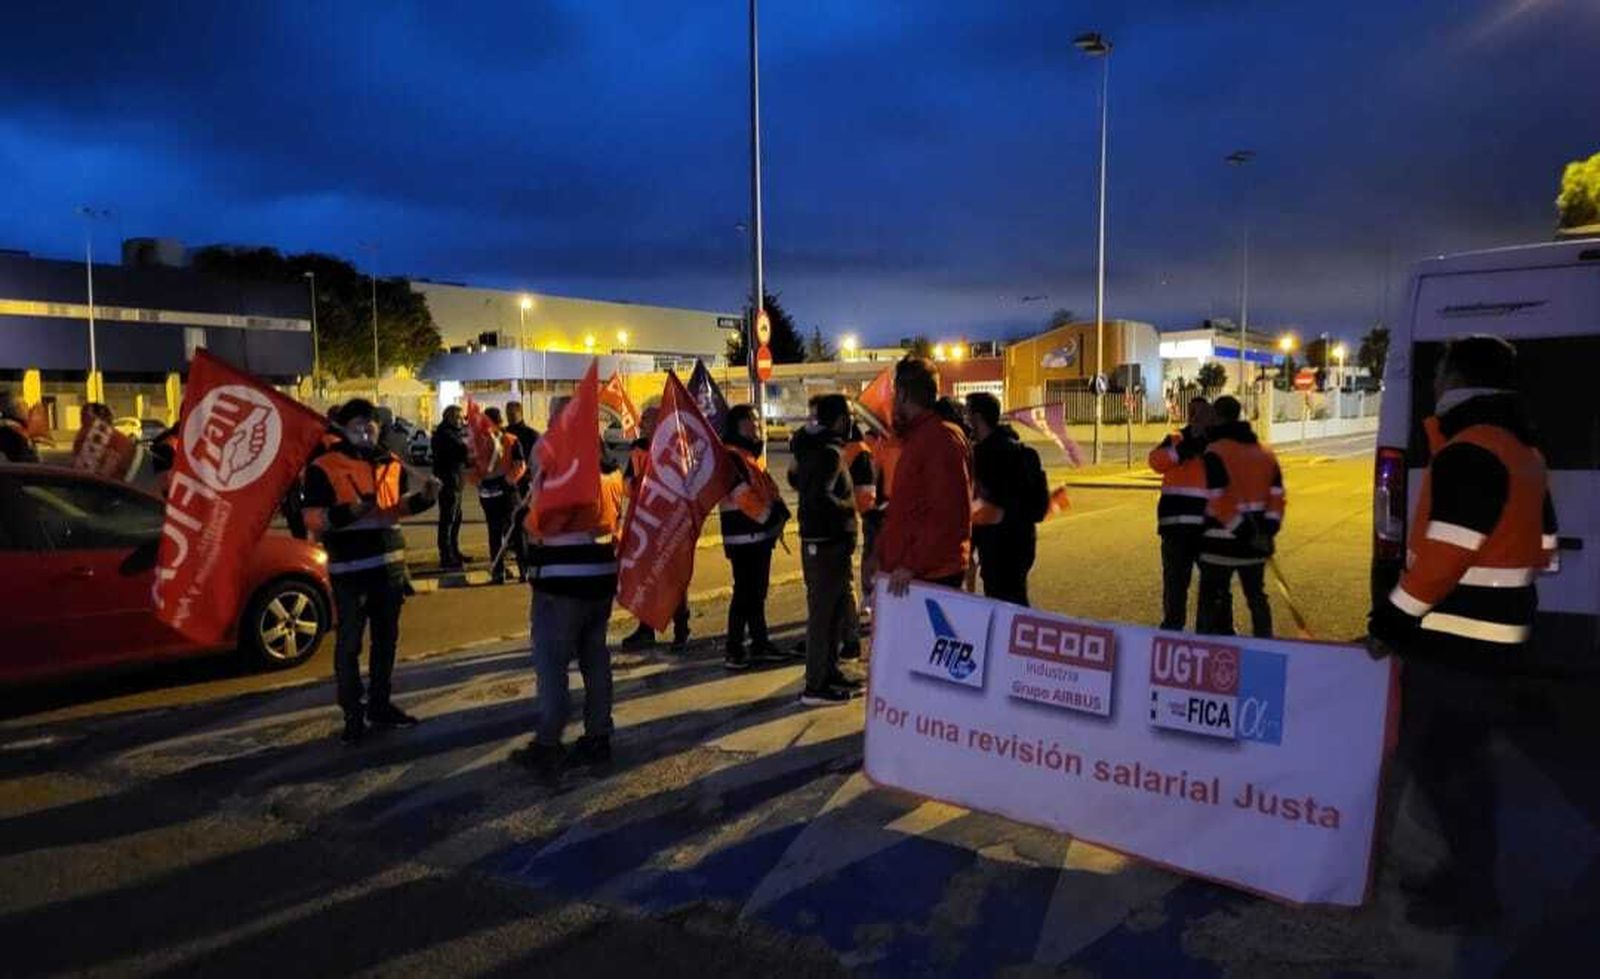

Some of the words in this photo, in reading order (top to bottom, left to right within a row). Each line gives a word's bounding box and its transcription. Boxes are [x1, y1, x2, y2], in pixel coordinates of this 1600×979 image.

[1015, 622, 1106, 662] CCOO
[1154, 640, 1210, 686] UGT
[1187, 697, 1232, 730] FICA
[873, 697, 910, 727] Por
[915, 714, 960, 743] una
[968, 728, 1082, 776] revisión
[1093, 758, 1220, 806] salarial
[1233, 783, 1341, 830] Justa
